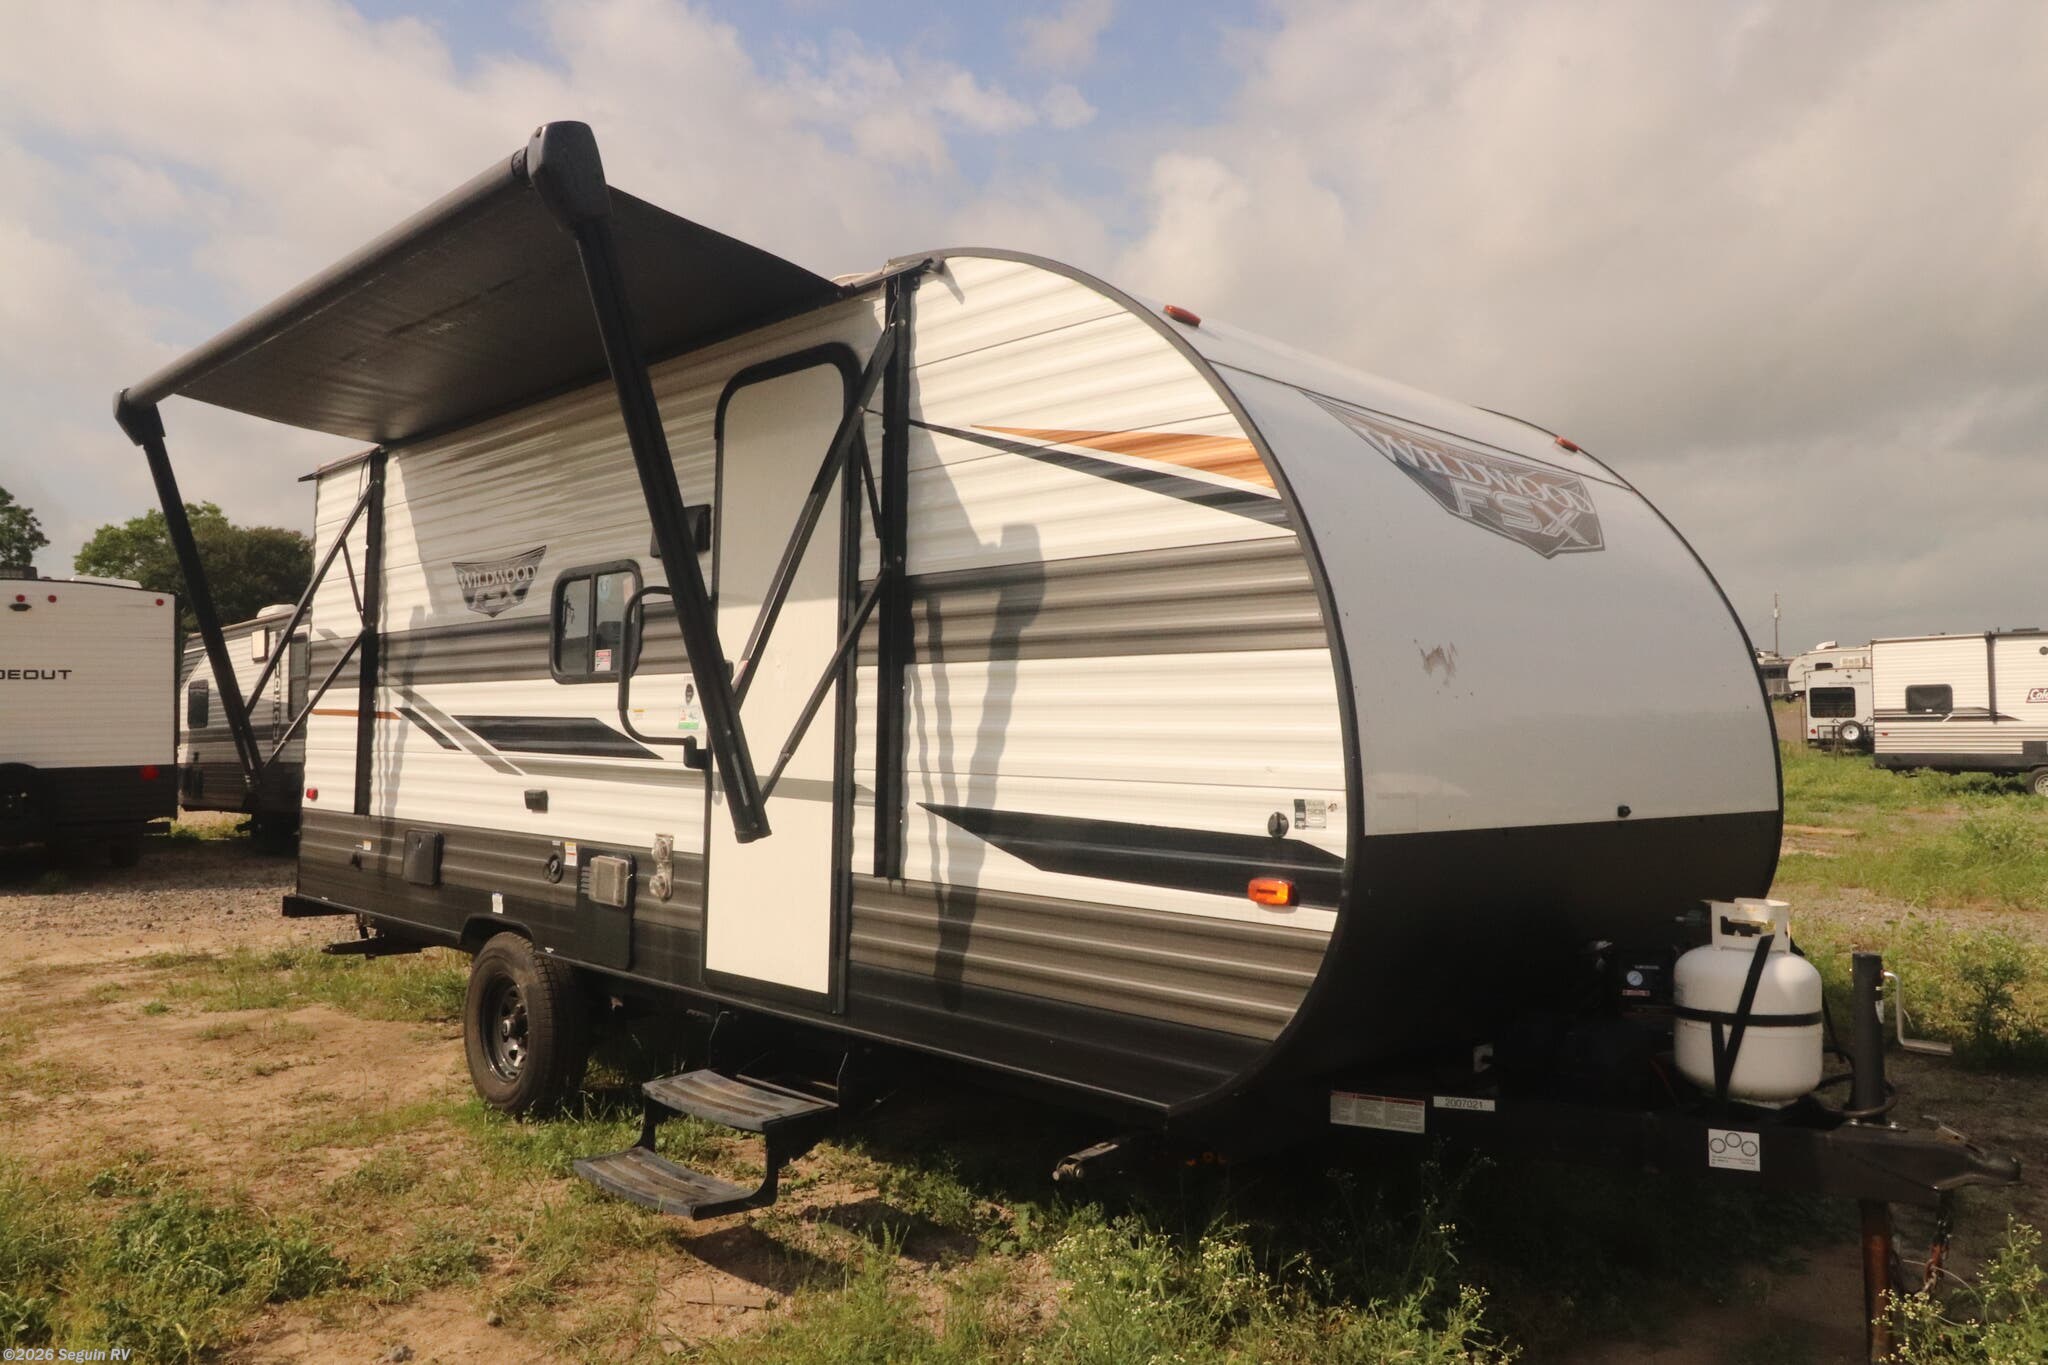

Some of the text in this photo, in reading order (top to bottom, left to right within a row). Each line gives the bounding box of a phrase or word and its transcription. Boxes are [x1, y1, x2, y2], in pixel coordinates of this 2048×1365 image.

[1358, 428, 1594, 514] WILDWOOD
[1449, 476, 1592, 546] FSX
[458, 565, 536, 590] WILDWOOD
[2030, 689, 2048, 700] Col
